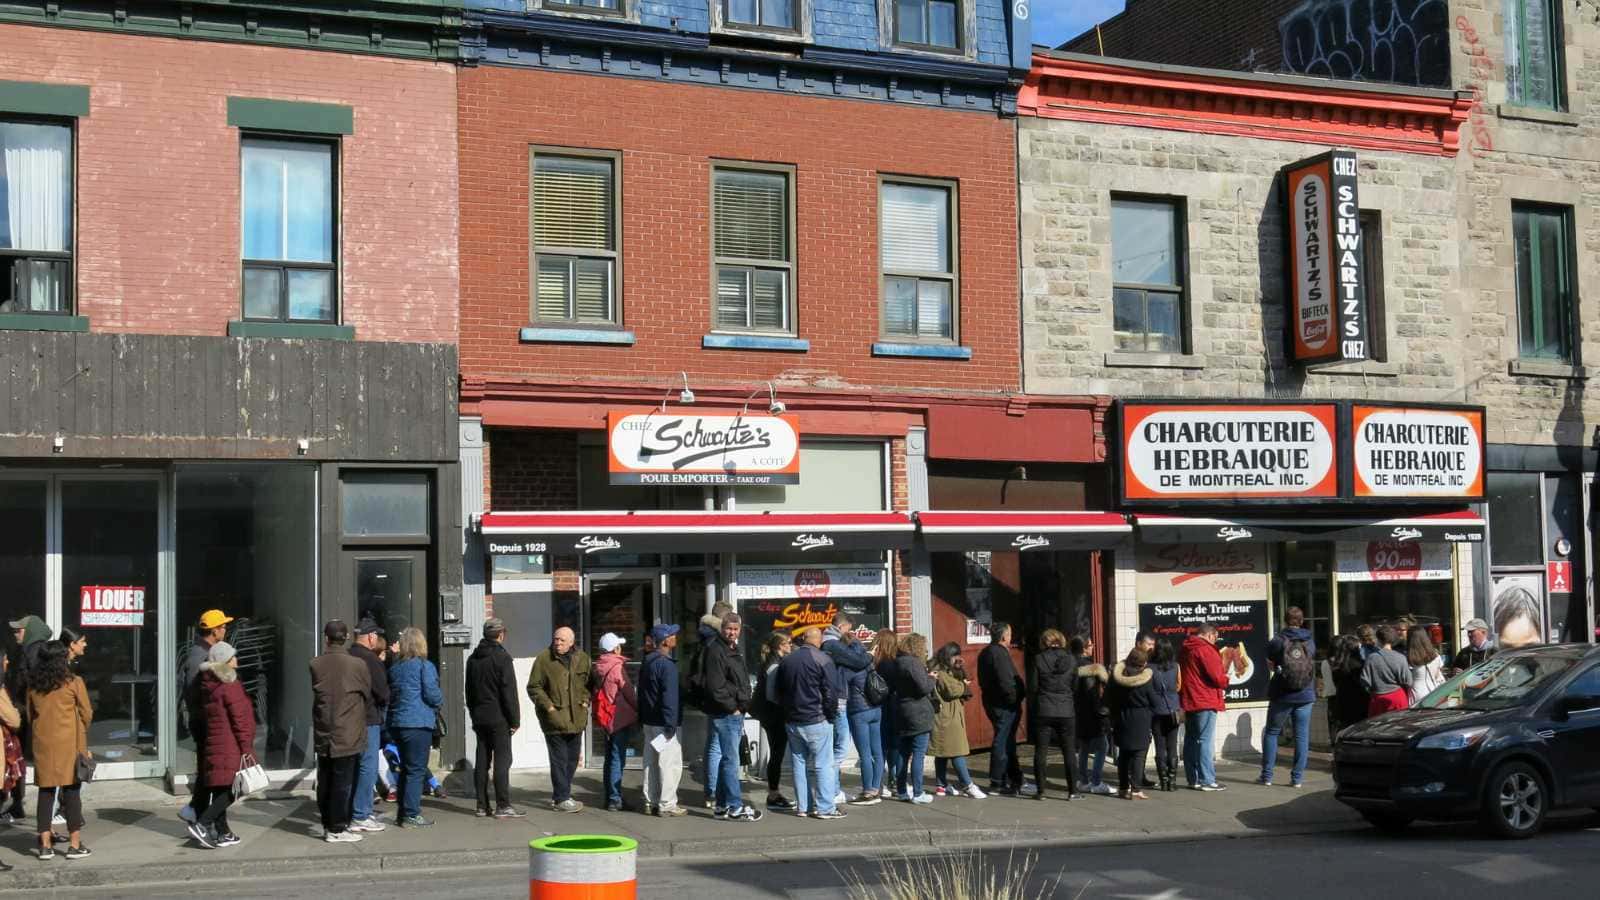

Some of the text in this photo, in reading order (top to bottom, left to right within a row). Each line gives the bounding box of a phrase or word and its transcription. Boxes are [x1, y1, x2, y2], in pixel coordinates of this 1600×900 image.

[1333, 157, 1357, 176] CHEZ
[1303, 181, 1322, 301] SCHWARTZ'S
[1336, 185, 1360, 337] SCHWARTZ'S
[1302, 303, 1329, 320] BIFTECK
[1342, 340, 1365, 359] CHEZ
[621, 422, 652, 431] CHEZ
[1144, 421, 1315, 443] CHARCUTERIE
[1364, 422, 1469, 446] CHARCUTERIE
[640, 417, 770, 471] Schwartz's
[1153, 449, 1309, 472] HEBRAIQUE
[1370, 450, 1466, 474] HEBRAIQUE
[640, 474, 670, 483] POUR
[673, 474, 728, 483] EMPORTER
[1160, 473, 1309, 487] DE MONTREAL INC.
[1375, 474, 1466, 486] DE MONTREAL INC.
[1444, 533, 1466, 541] Depuis
[490, 544, 546, 553] Depuis 1928
[1375, 550, 1400, 570] 90
[799, 579, 816, 591] 90
[94, 588, 145, 610] LOUER
[1154, 603, 1252, 616] Service de Traiteur
[1178, 615, 1206, 623] Catering
[774, 602, 838, 637] Schwart
